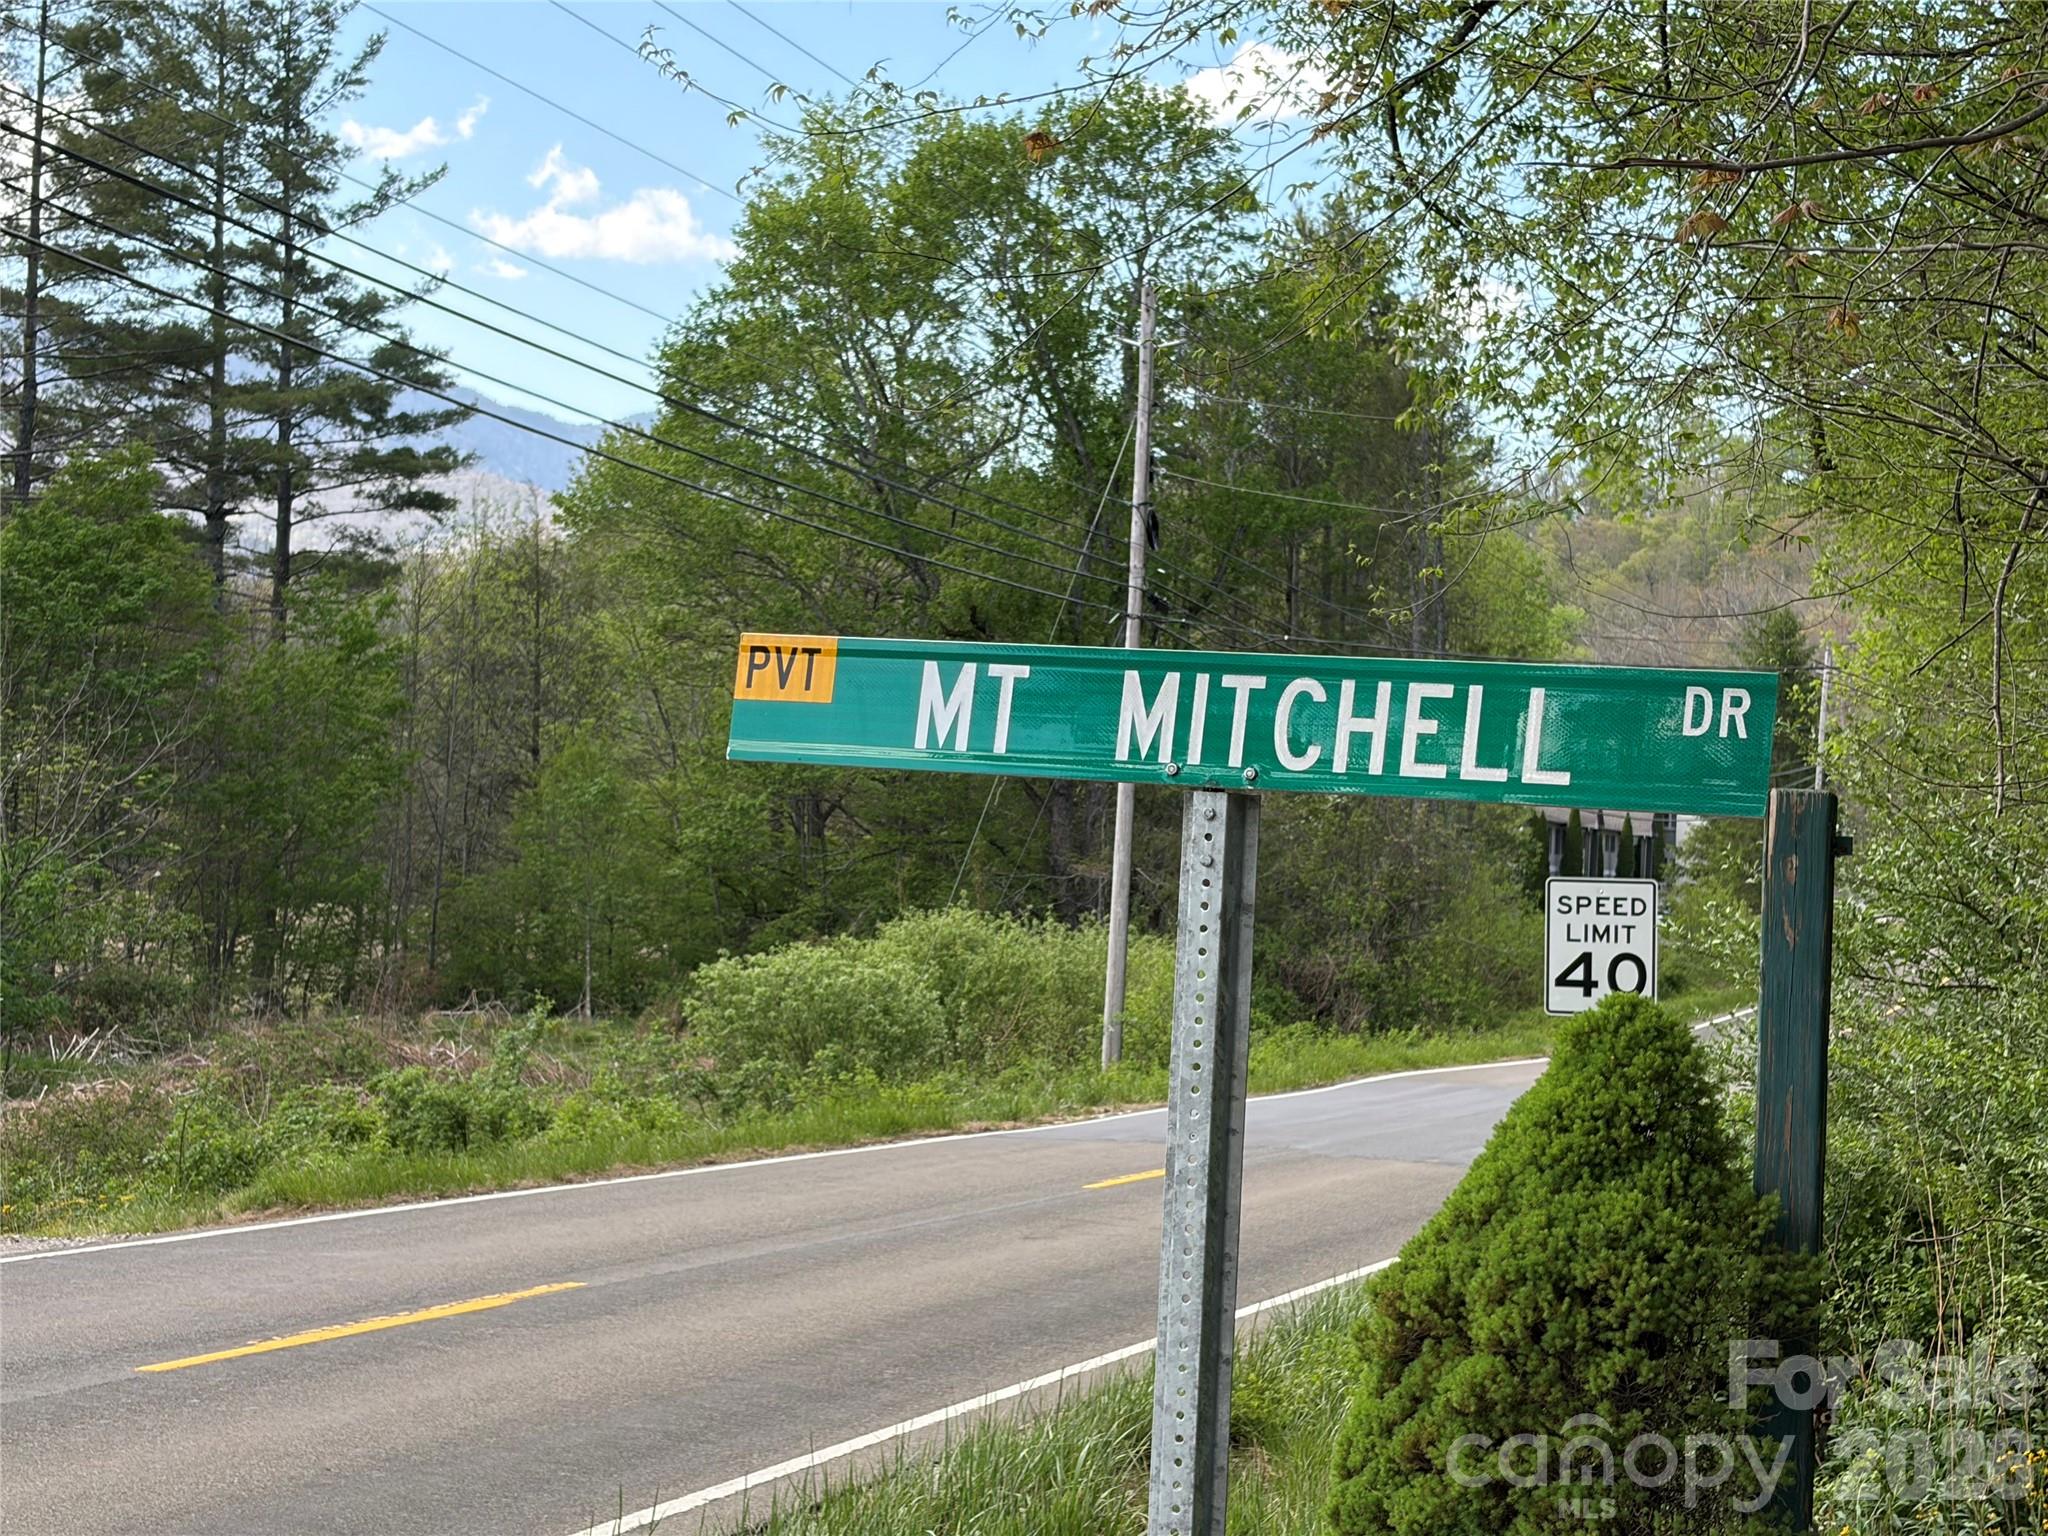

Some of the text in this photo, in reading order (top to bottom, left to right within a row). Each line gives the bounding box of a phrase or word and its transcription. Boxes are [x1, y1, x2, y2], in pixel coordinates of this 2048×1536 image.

[745, 645, 822, 691] PVT
[914, 660, 1752, 786] MT MITCHELL DR
[1556, 895, 1647, 917] SPEED
[1566, 923, 1636, 944] LIMIT
[1554, 951, 1648, 998] 40
